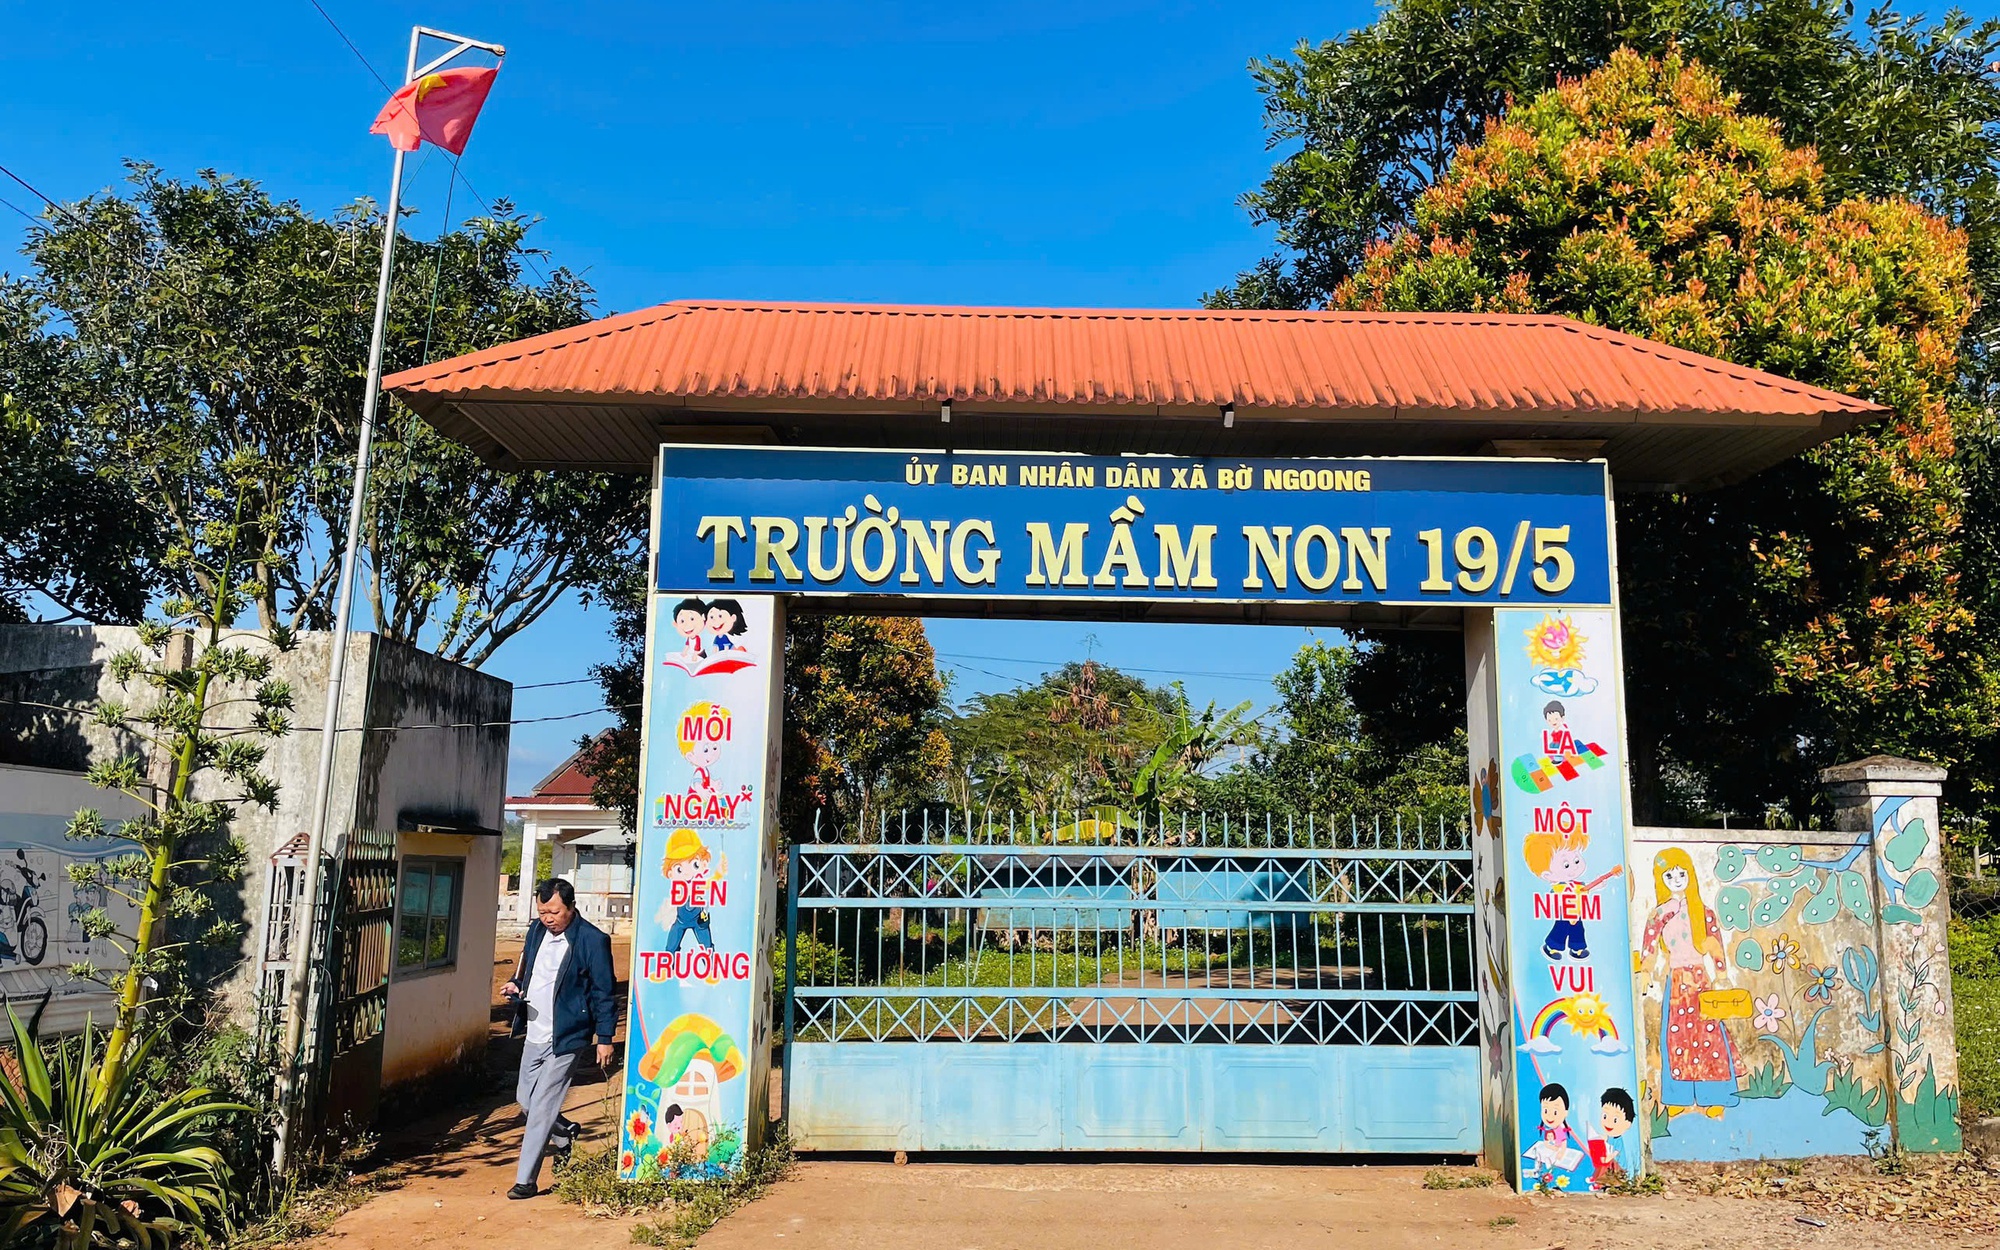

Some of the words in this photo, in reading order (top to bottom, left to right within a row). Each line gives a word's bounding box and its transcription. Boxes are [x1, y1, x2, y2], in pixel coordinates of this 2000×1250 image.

[905, 456, 939, 485] ỦY
[952, 464, 1007, 486] BAN
[1019, 461, 1095, 488] NHÂN
[1105, 462, 1161, 489] DÂN
[1171, 464, 1208, 489] XÃ
[1217, 464, 1254, 490] BỜ
[1263, 469, 1371, 491] NGOONG
[696, 494, 1001, 584] TRƯỜNG
[1025, 495, 1218, 588] MẦM
[1242, 525, 1391, 590] NON
[1419, 520, 1575, 595] 19/5
[683, 705, 732, 742] MỖI
[1543, 724, 1577, 755] LÀ
[664, 787, 741, 820] NGÀY
[1534, 802, 1592, 838] MỘT
[671, 868, 727, 906] ĐẾN
[1534, 883, 1601, 920] NIỀM
[640, 944, 750, 980] TRƯỜNG
[1549, 966, 1593, 992] VUI
